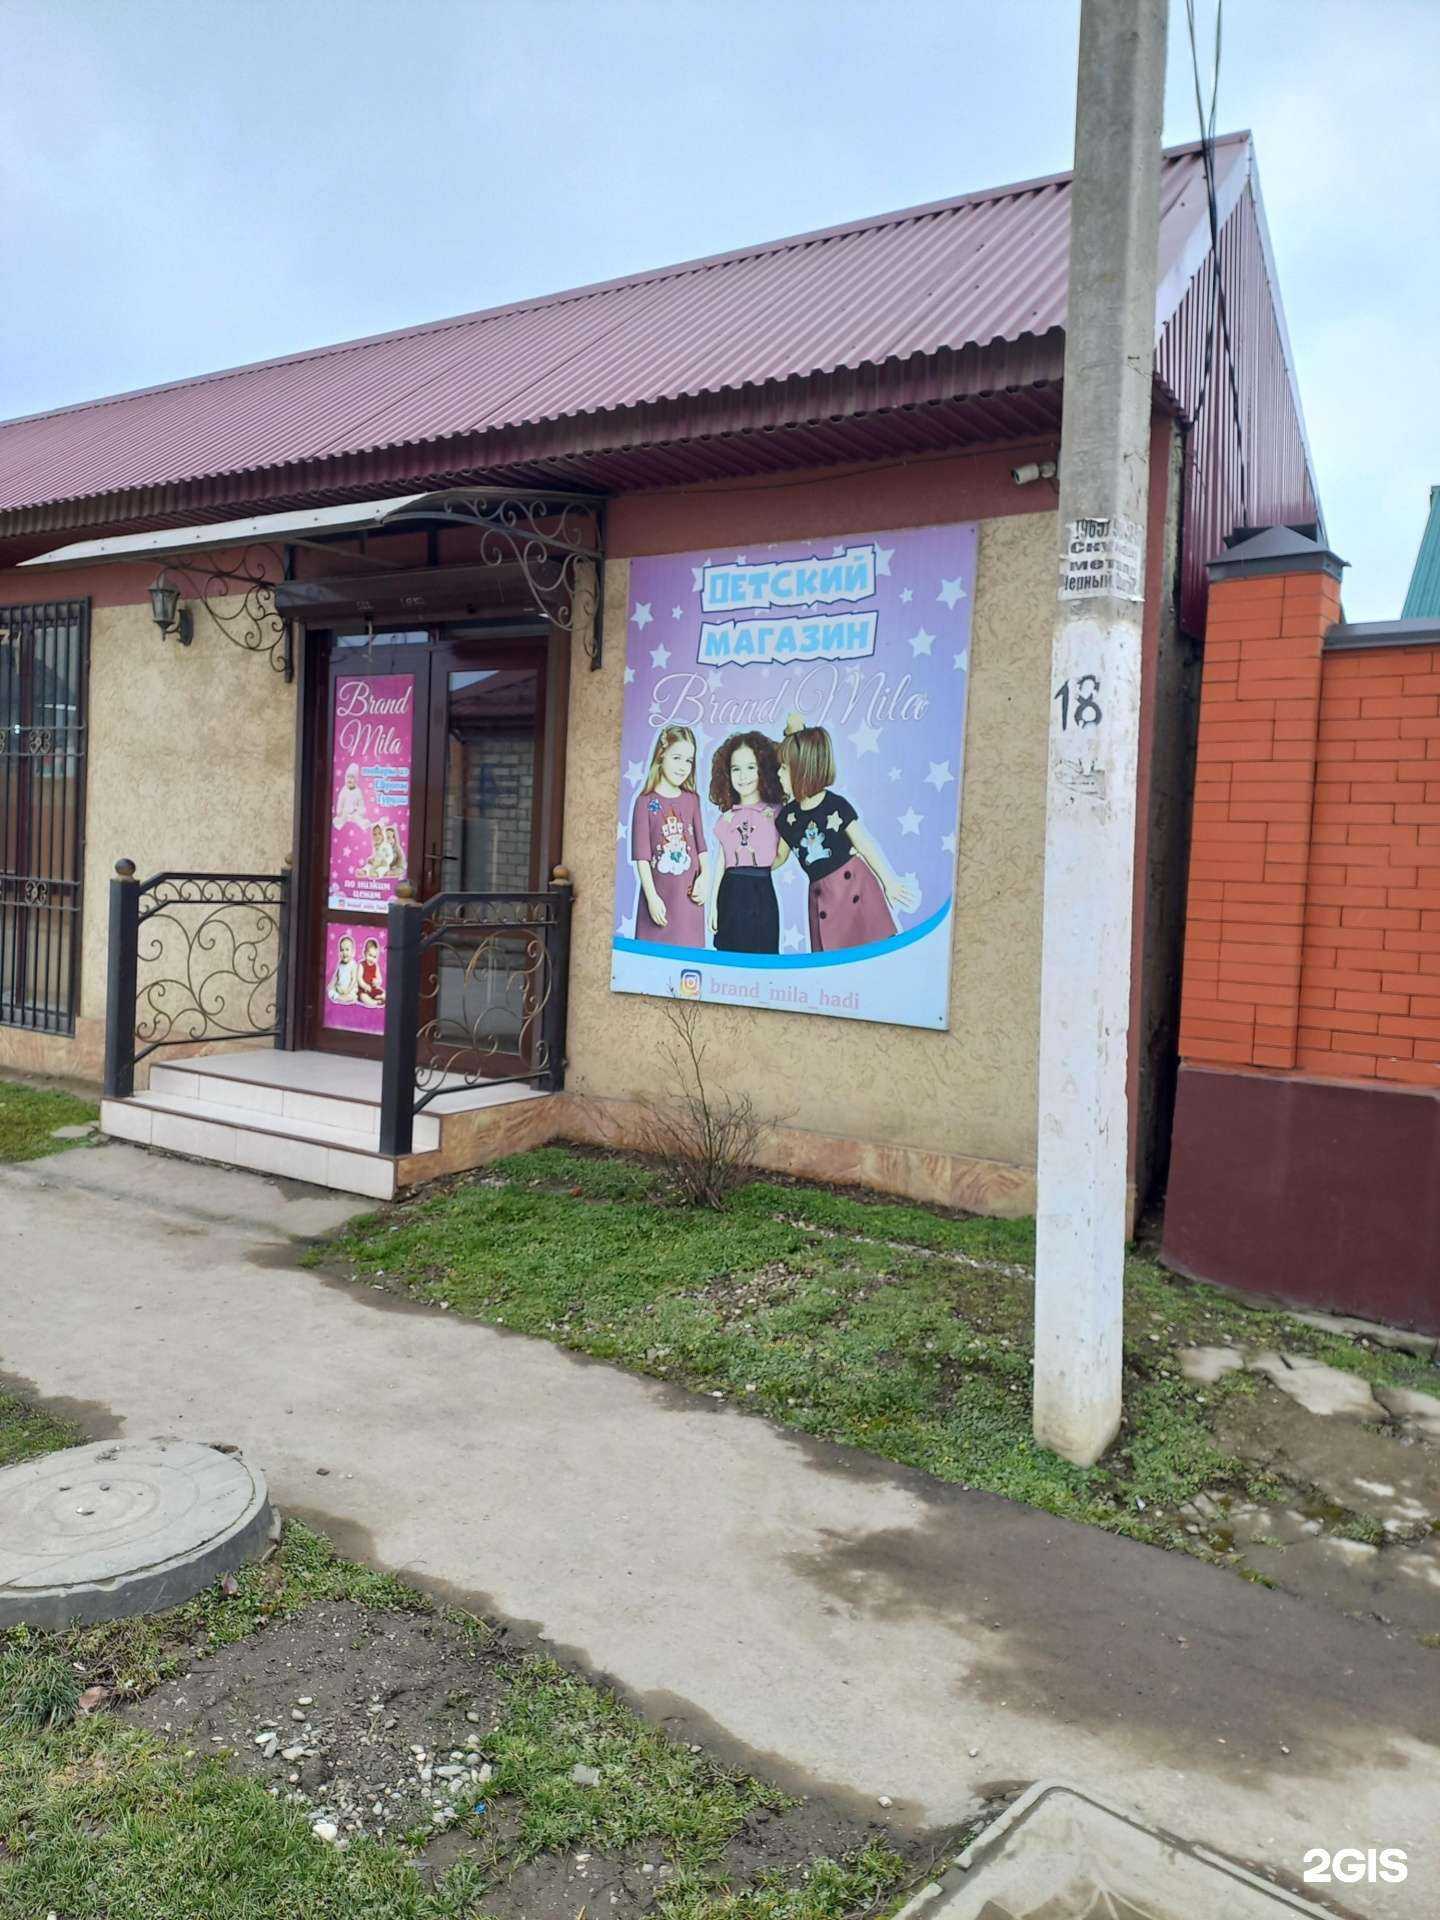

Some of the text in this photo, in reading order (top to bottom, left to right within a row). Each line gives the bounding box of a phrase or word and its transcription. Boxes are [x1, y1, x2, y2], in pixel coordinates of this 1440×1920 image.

[709, 555, 868, 604] ДЕТСКИЙ
[704, 621, 870, 656] МАГАЗИН
[336, 681, 412, 717] Brand
[648, 664, 930, 728] Brand Mila
[1054, 675, 1102, 731] 18
[339, 719, 402, 758] Mila
[709, 977, 861, 1010] brand_mila_hadi
